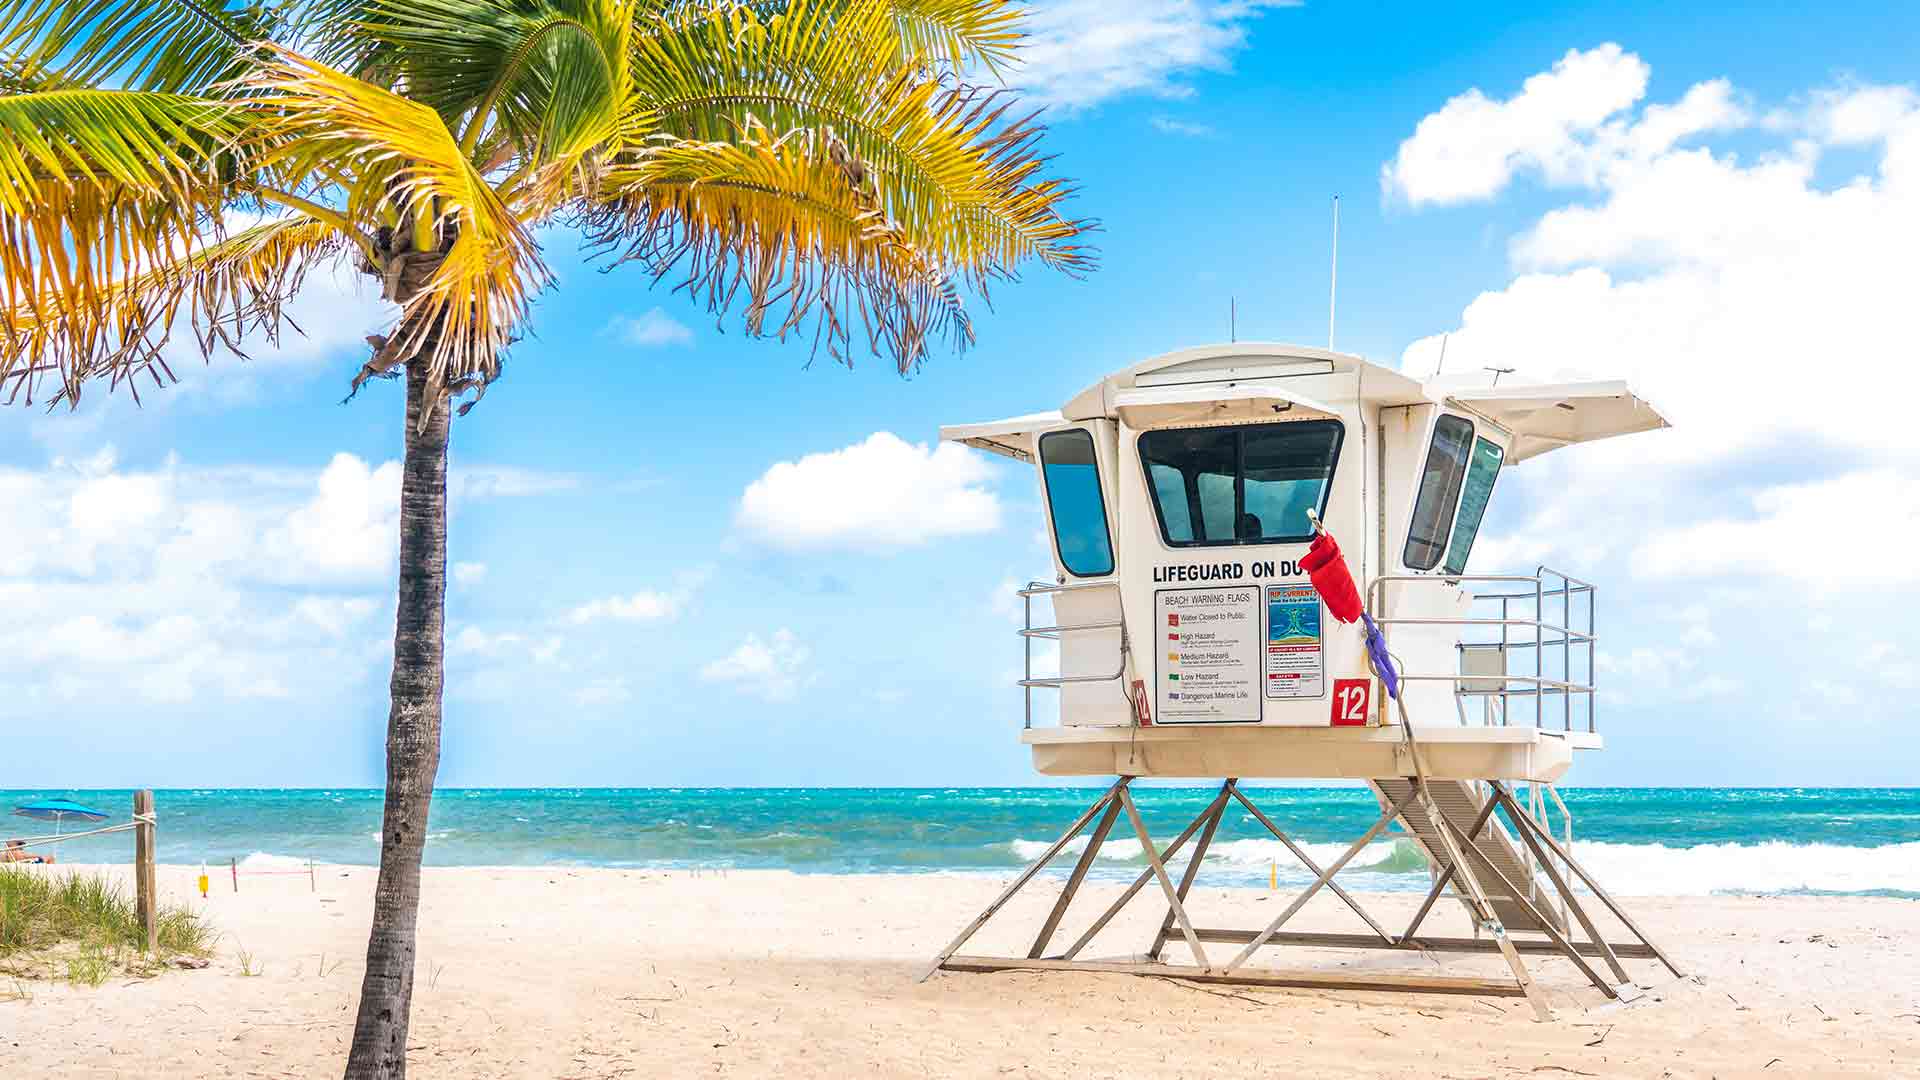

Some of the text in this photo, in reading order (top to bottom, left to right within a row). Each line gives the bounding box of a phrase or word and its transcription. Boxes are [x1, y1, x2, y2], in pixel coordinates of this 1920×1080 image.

[1153, 563, 1243, 582] LIFEGUARD
[1251, 561, 1274, 578] ON
[1165, 593, 1250, 605] BEACH WARNING FLAGS
[1199, 612, 1218, 620] Closed
[1220, 611, 1226, 619] to
[1180, 632, 1215, 641] High Hazard
[1195, 672, 1219, 680] Hazard
[1181, 693, 1213, 701] Dangerous
[1214, 691, 1235, 699] Marine
[1338, 686, 1366, 720] 12
